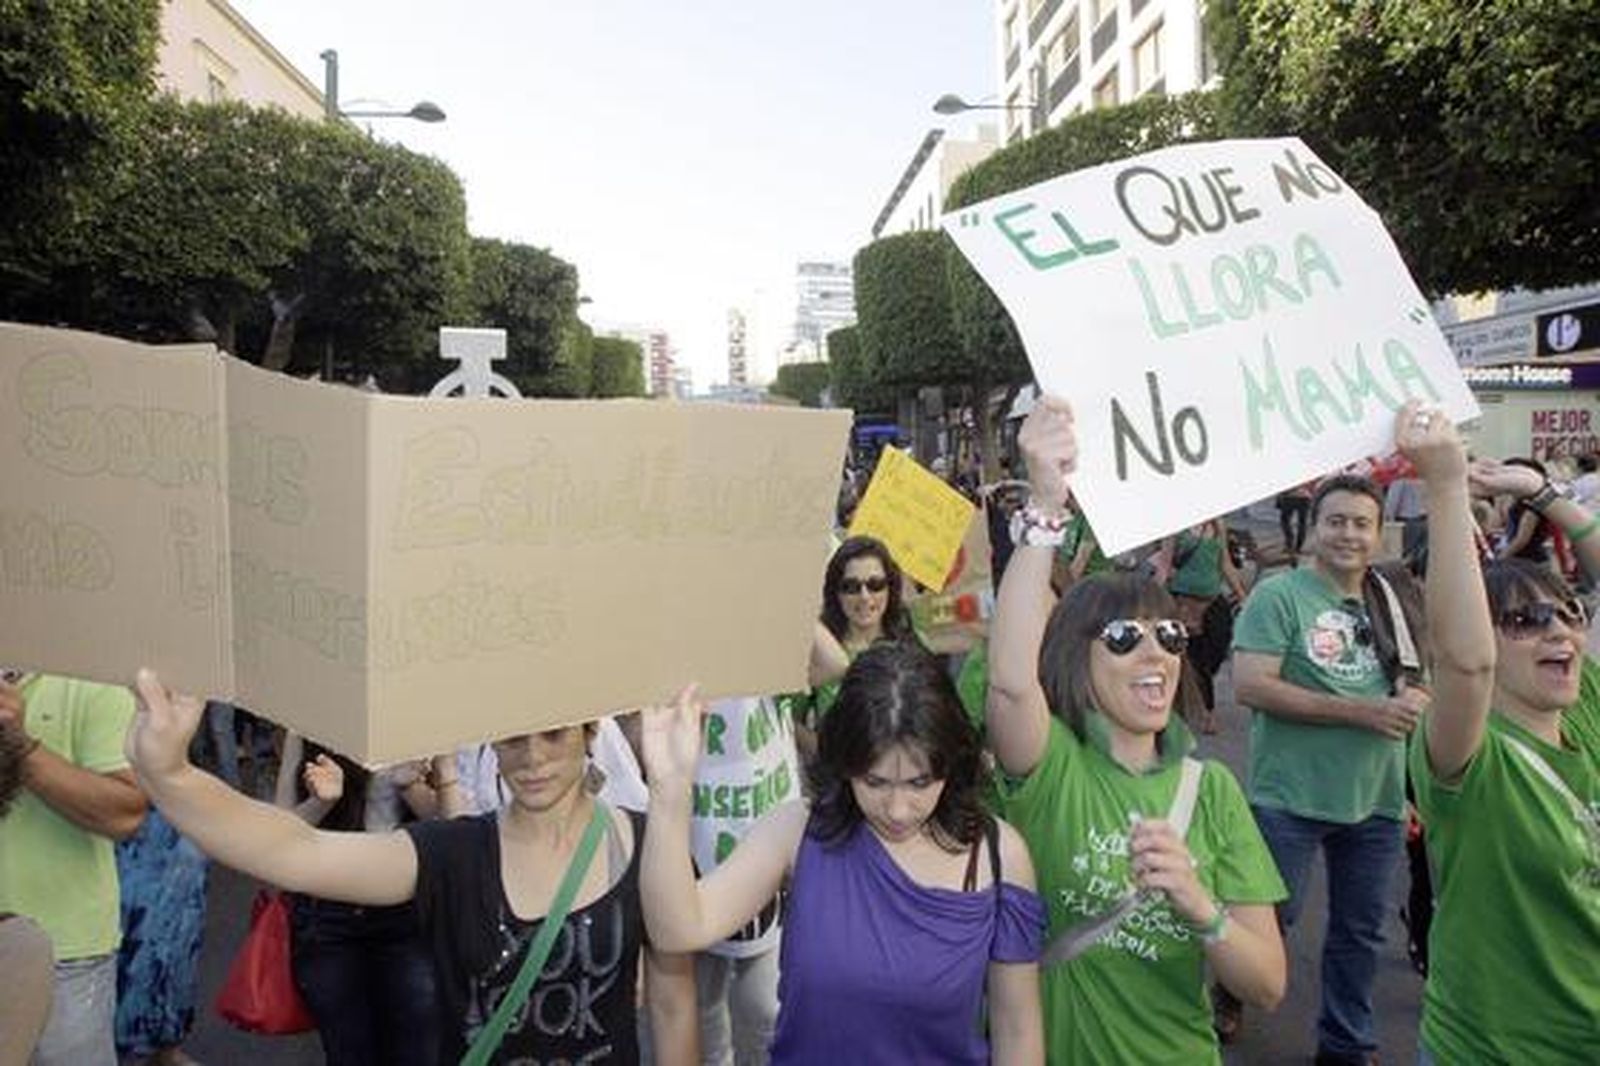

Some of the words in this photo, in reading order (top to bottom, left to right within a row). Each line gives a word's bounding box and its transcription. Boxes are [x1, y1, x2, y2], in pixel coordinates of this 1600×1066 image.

[1113, 165, 1262, 246] QUE
[1127, 232, 1342, 339] LLORA
[1531, 410, 1592, 433] MEJOR
